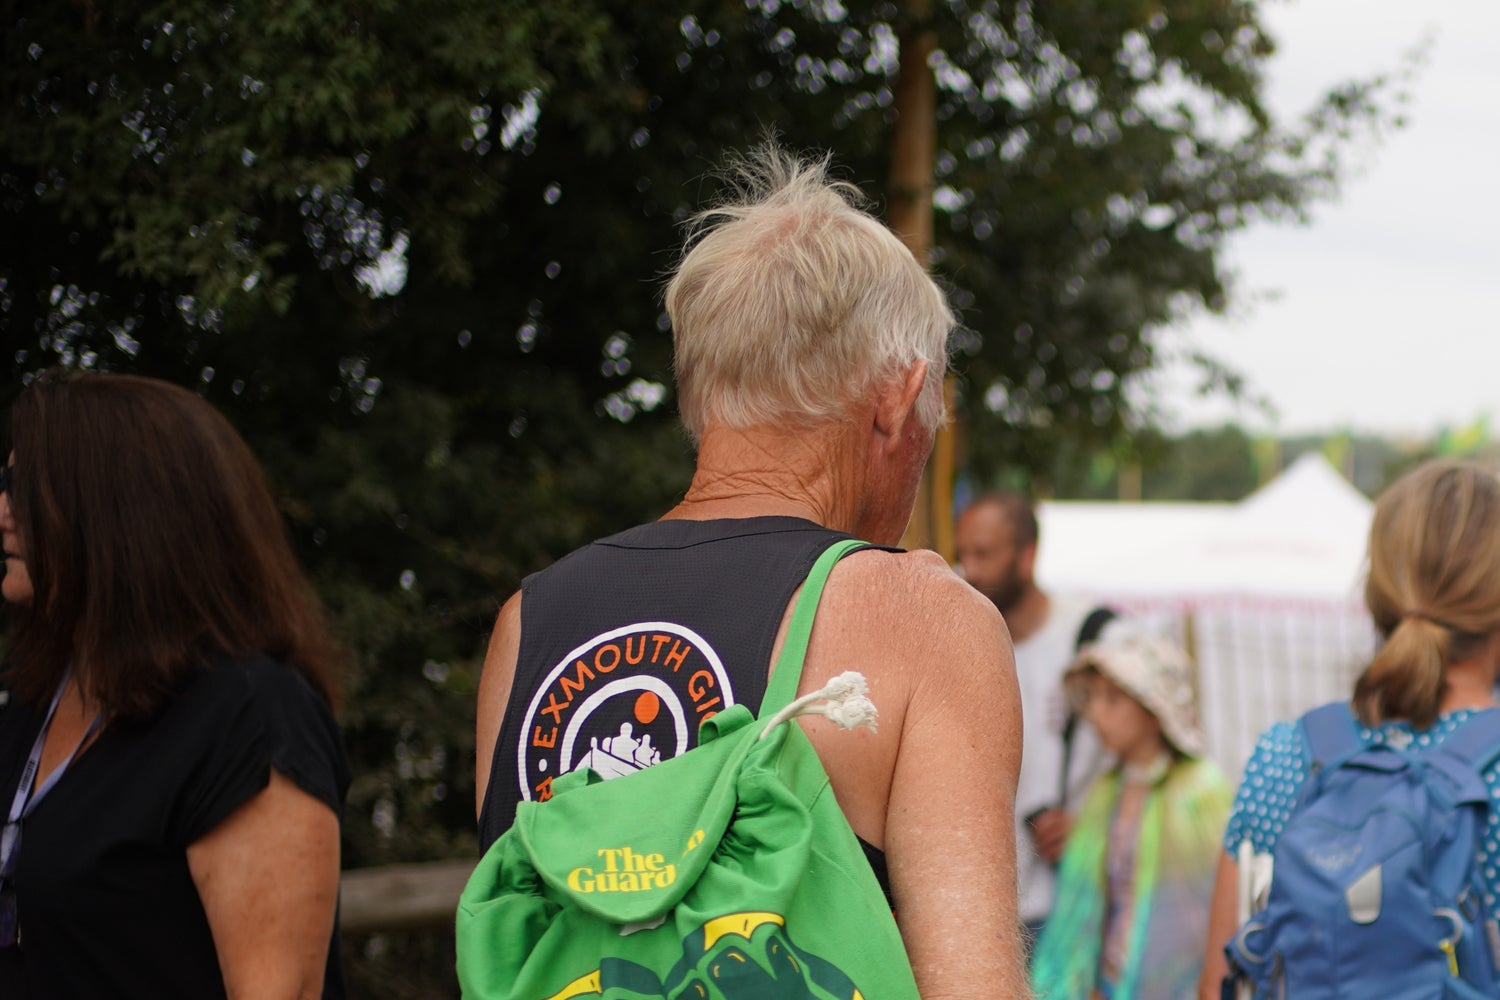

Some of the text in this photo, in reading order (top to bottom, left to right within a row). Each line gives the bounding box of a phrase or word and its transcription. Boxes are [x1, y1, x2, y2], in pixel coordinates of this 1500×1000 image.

[533, 634, 691, 749] EXMOUTH
[597, 846, 665, 873] The
[567, 863, 677, 894] Guard
